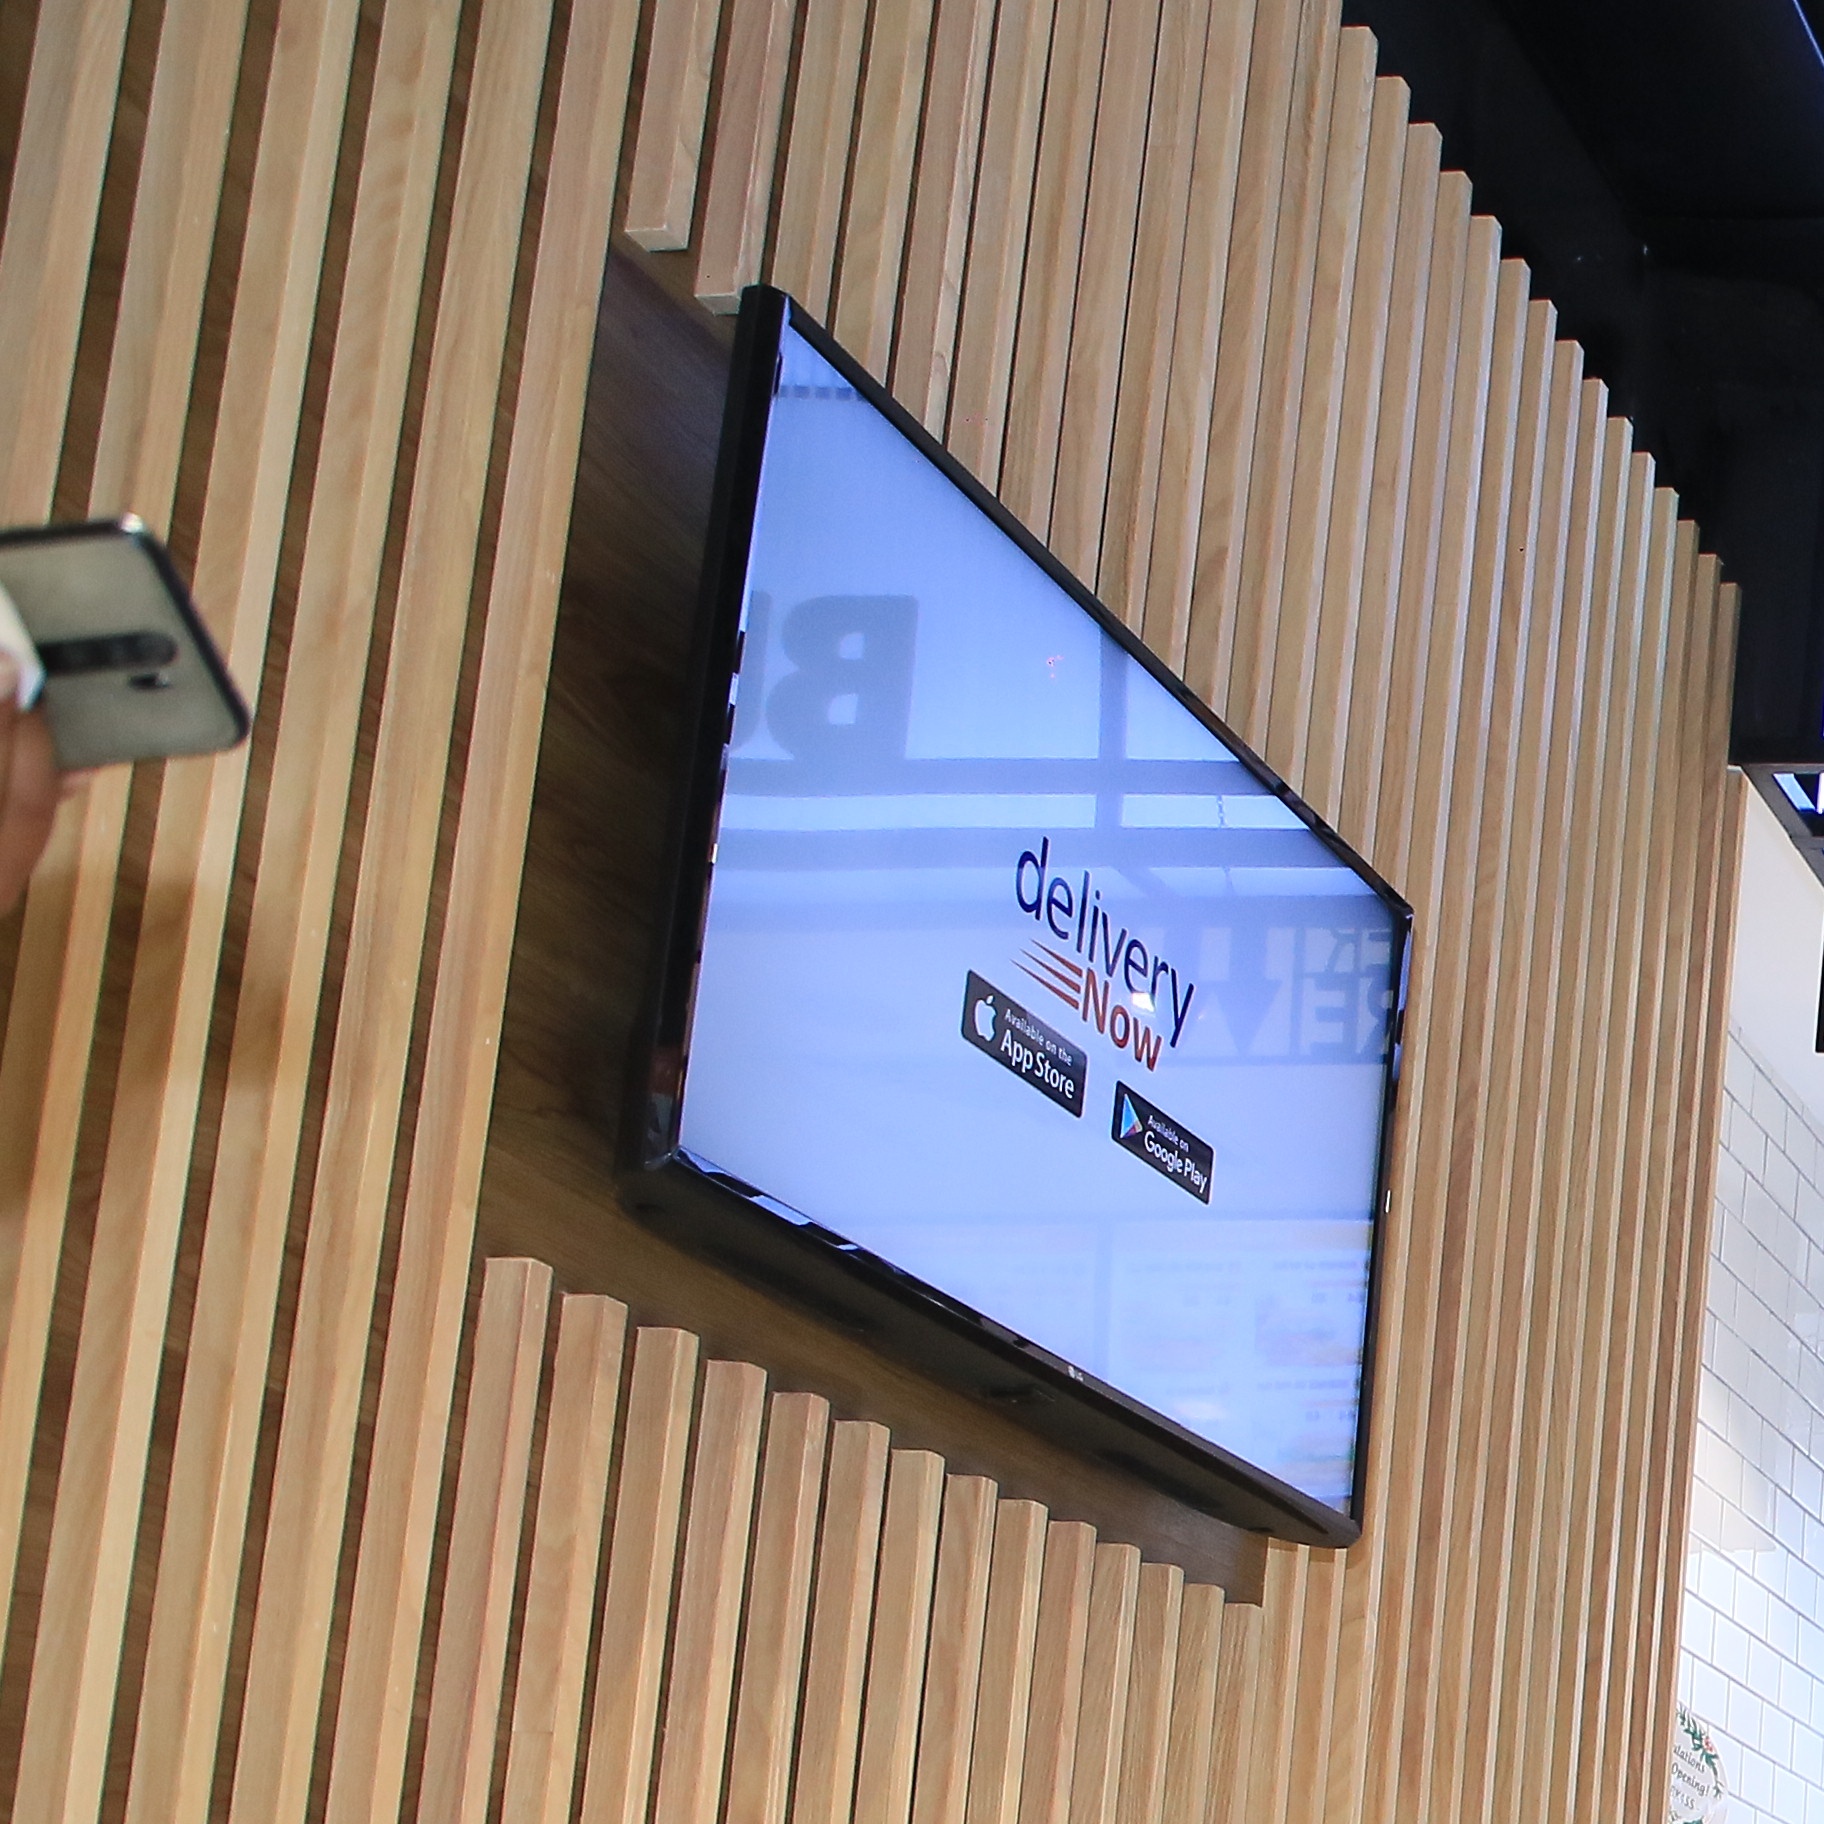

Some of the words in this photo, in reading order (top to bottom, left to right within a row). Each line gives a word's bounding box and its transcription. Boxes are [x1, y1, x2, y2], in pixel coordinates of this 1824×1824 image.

[1016, 836, 1194, 1048] delivery
[1000, 1028, 1034, 1074] App
[1034, 1052, 1076, 1101] Store
[1004, 1008, 1045, 1055] Available
[1045, 1040, 1057, 1058] on
[1058, 1043, 1073, 1067] the
[1144, 1129, 1184, 1174] Google
[1183, 1153, 1208, 1194] Play
[1147, 1113, 1179, 1150] Available
[1179, 1137, 1190, 1153] on
[1671, 1762, 1711, 1797] Opening!
